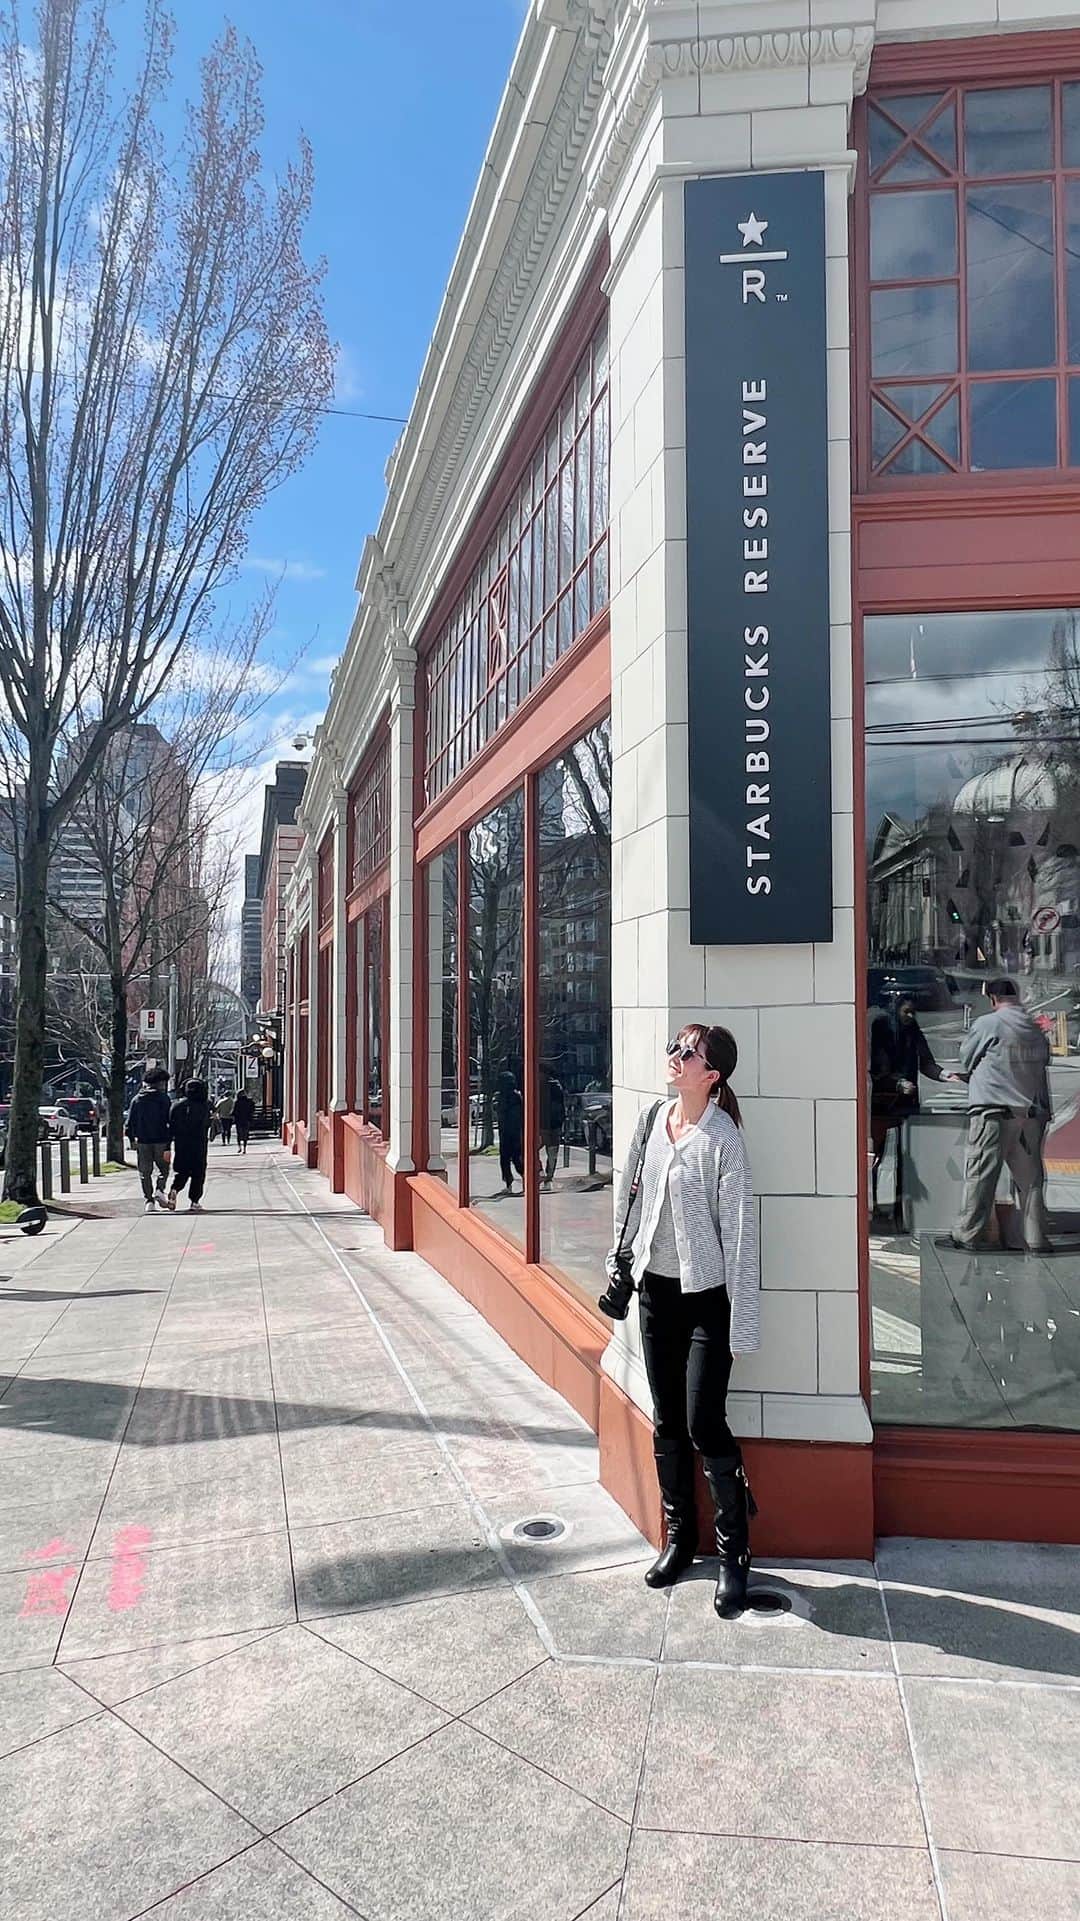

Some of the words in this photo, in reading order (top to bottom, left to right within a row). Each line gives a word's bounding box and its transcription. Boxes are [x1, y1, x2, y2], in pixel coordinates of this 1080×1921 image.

[742, 269, 766, 304] R
[742, 379, 768, 593] RESERVE
[744, 625, 771, 895] STARBUCKS
